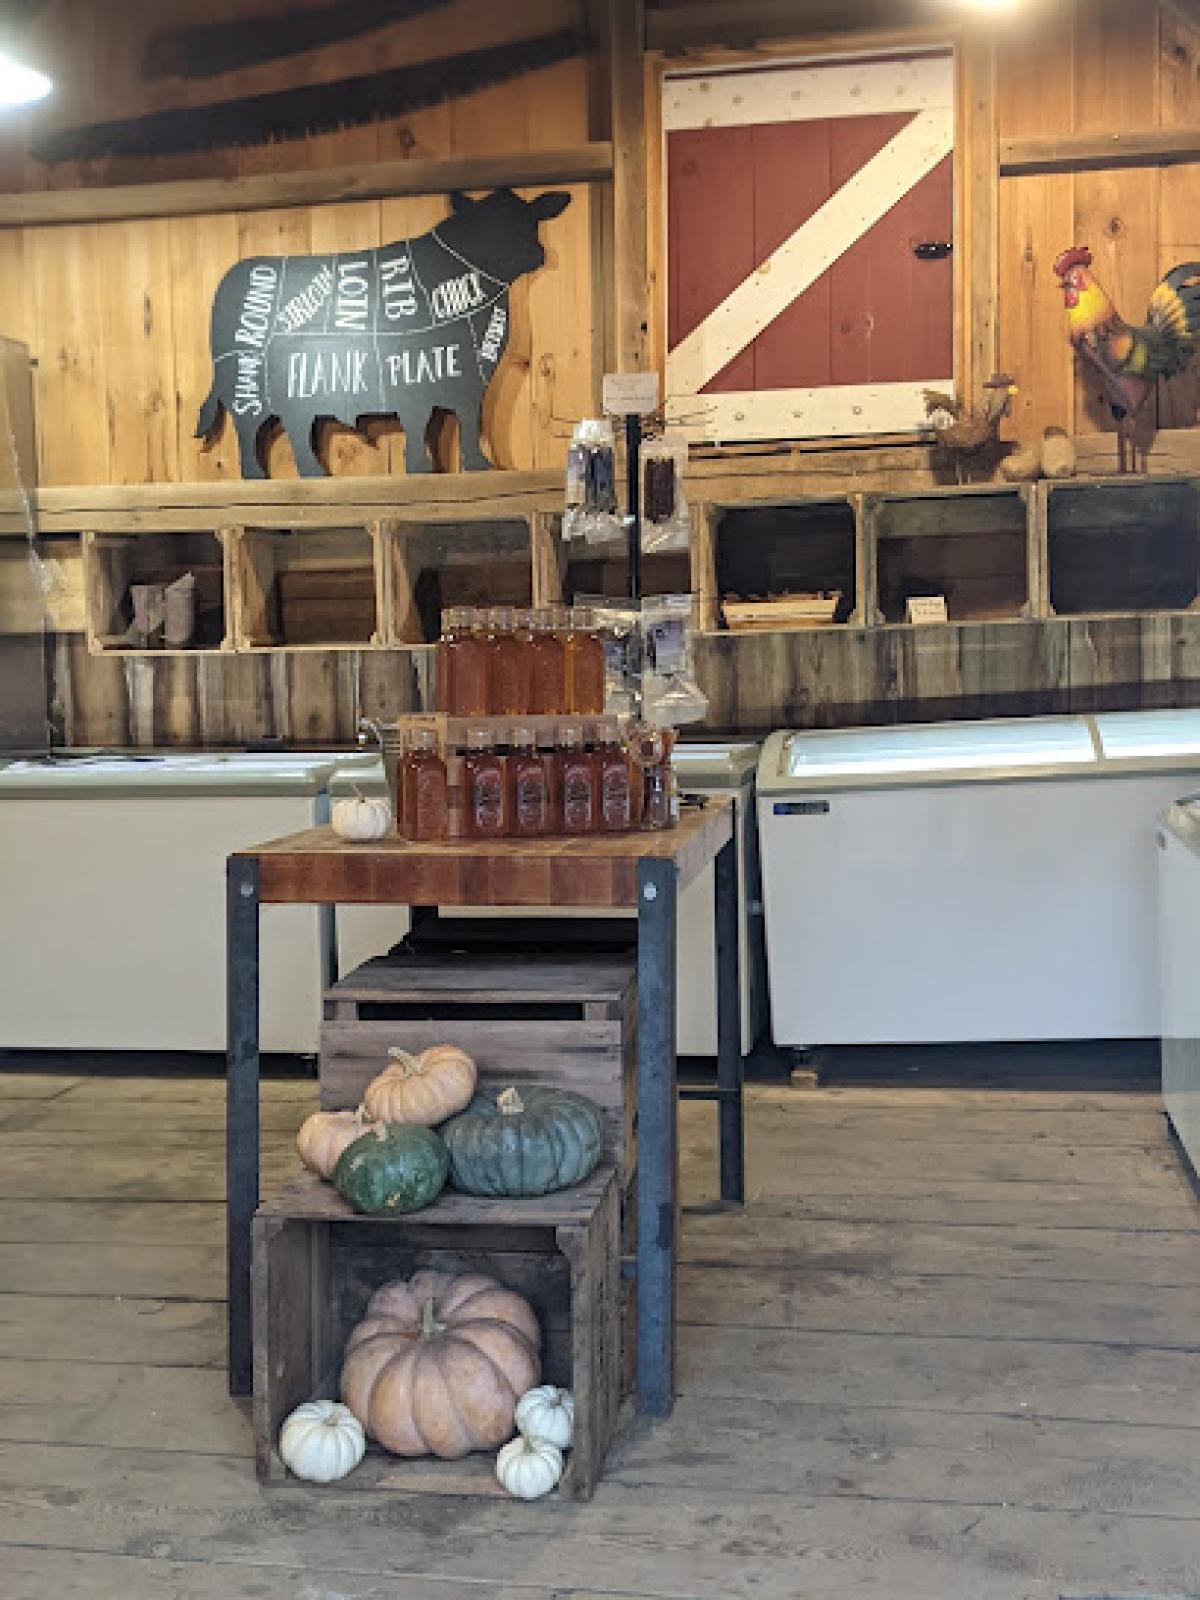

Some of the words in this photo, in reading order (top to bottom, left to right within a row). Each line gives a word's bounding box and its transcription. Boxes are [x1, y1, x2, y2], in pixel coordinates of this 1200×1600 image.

[235, 265, 277, 346] ROUND
[335, 261, 368, 331] LOIN
[381, 256, 417, 320] RIB
[232, 349, 262, 416] SHANK
[288, 350, 368, 397] FLANK
[385, 344, 462, 386] PLATE
